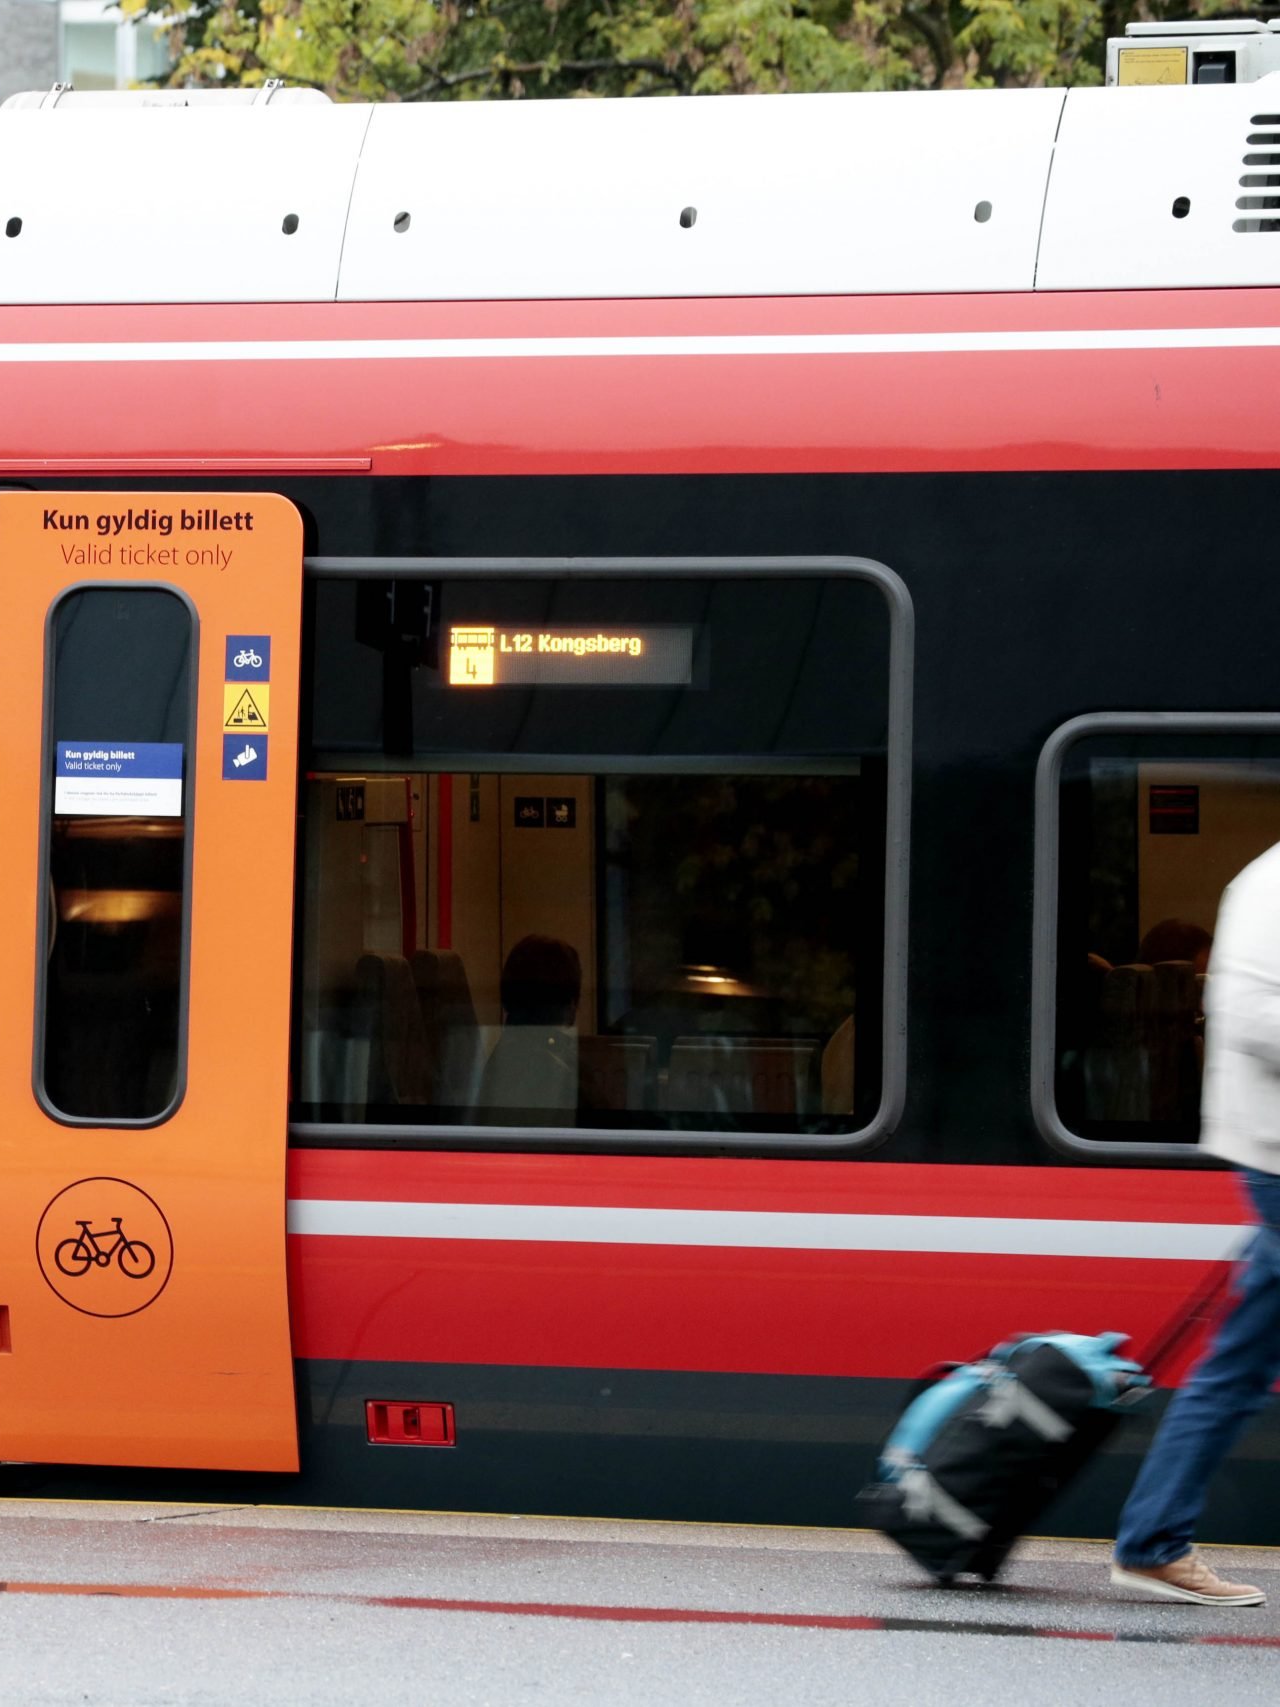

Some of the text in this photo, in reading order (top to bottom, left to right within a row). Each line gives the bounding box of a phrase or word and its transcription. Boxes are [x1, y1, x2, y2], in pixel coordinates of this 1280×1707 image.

[43, 508, 254, 536] Kun gyldig billett
[60, 543, 233, 571] Valid ticket only
[499, 633, 642, 656] L12 Kongsberg
[65, 750, 135, 761] Kun gyldig billett
[65, 761, 122, 773] Valid ticket only
